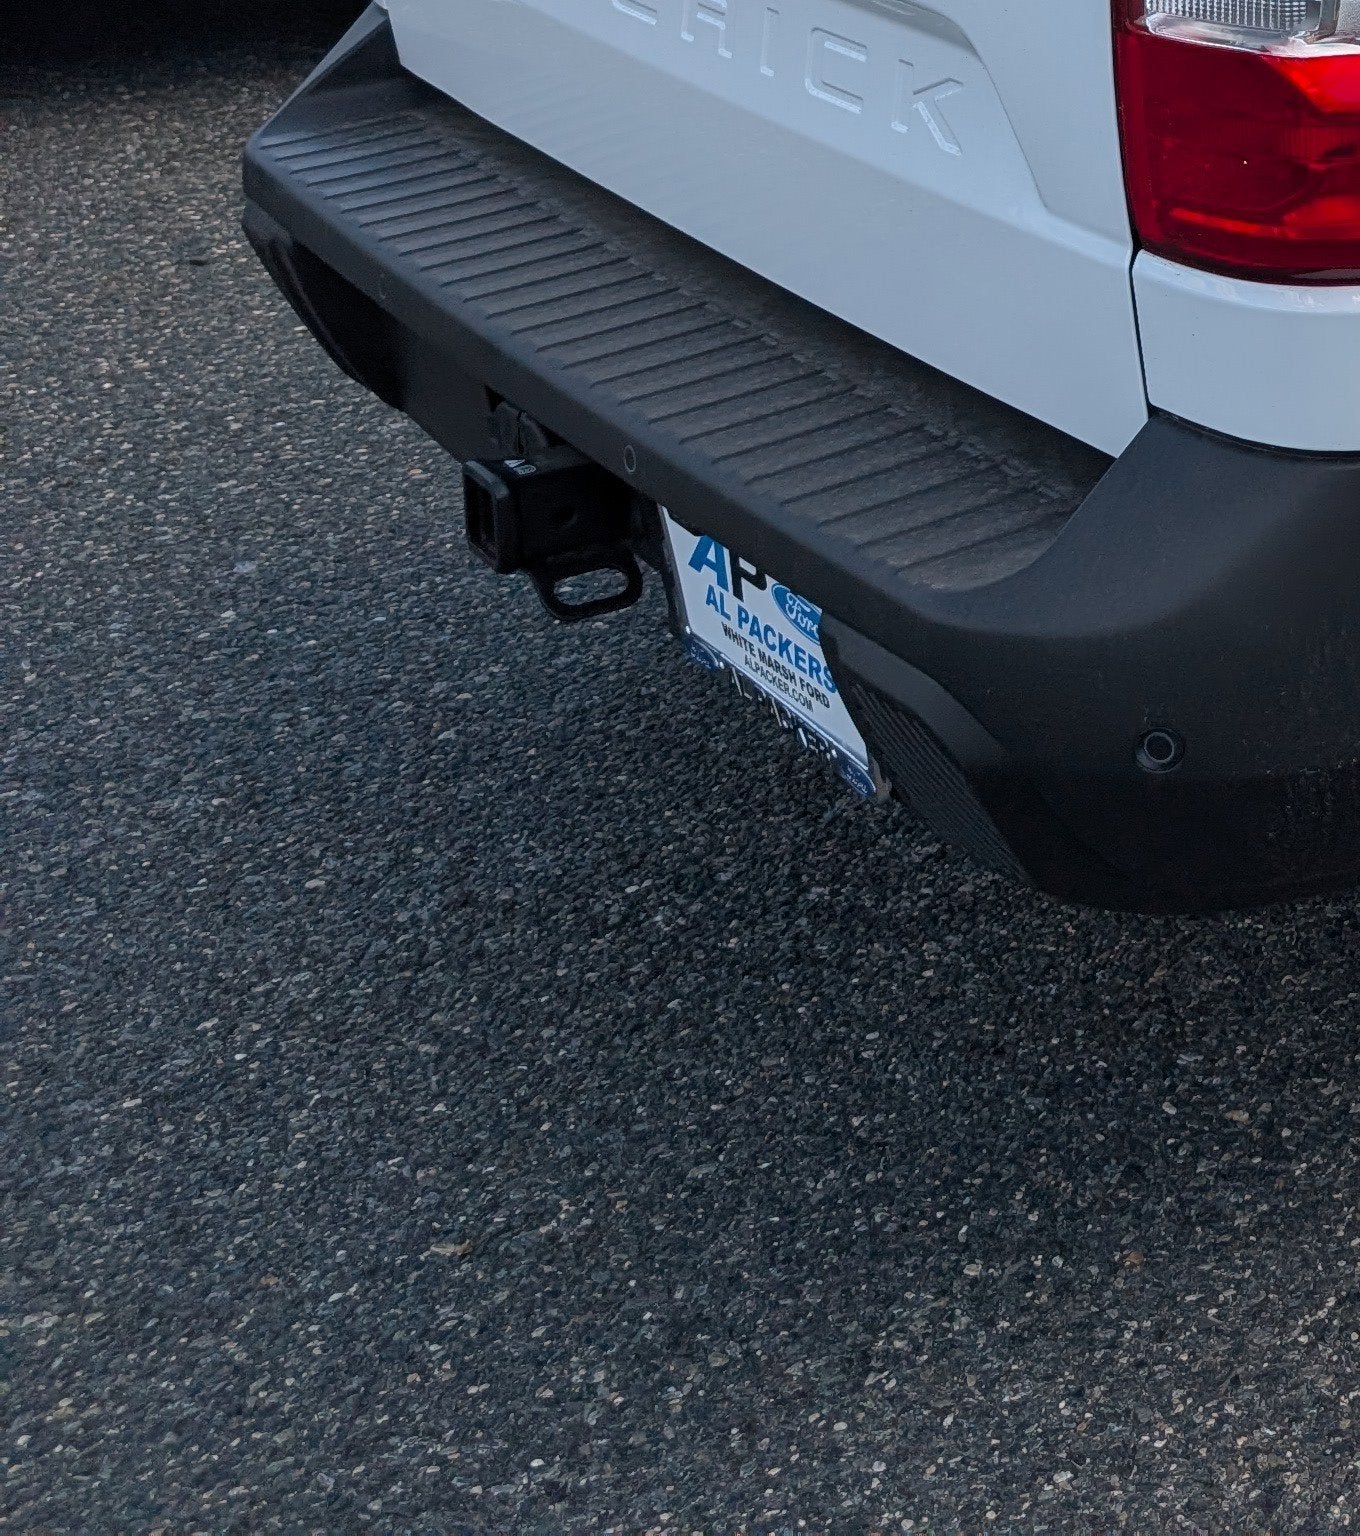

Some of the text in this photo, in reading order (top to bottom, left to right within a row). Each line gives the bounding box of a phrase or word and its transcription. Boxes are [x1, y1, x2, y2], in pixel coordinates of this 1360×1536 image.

[705, 584, 732, 621] AL
[737, 603, 838, 694] PACKERS
[721, 621, 756, 654] WHITE
[757, 648, 798, 687] MARSH
[799, 676, 831, 709] FORD
[744, 654, 814, 712] ALPACKER.COM
